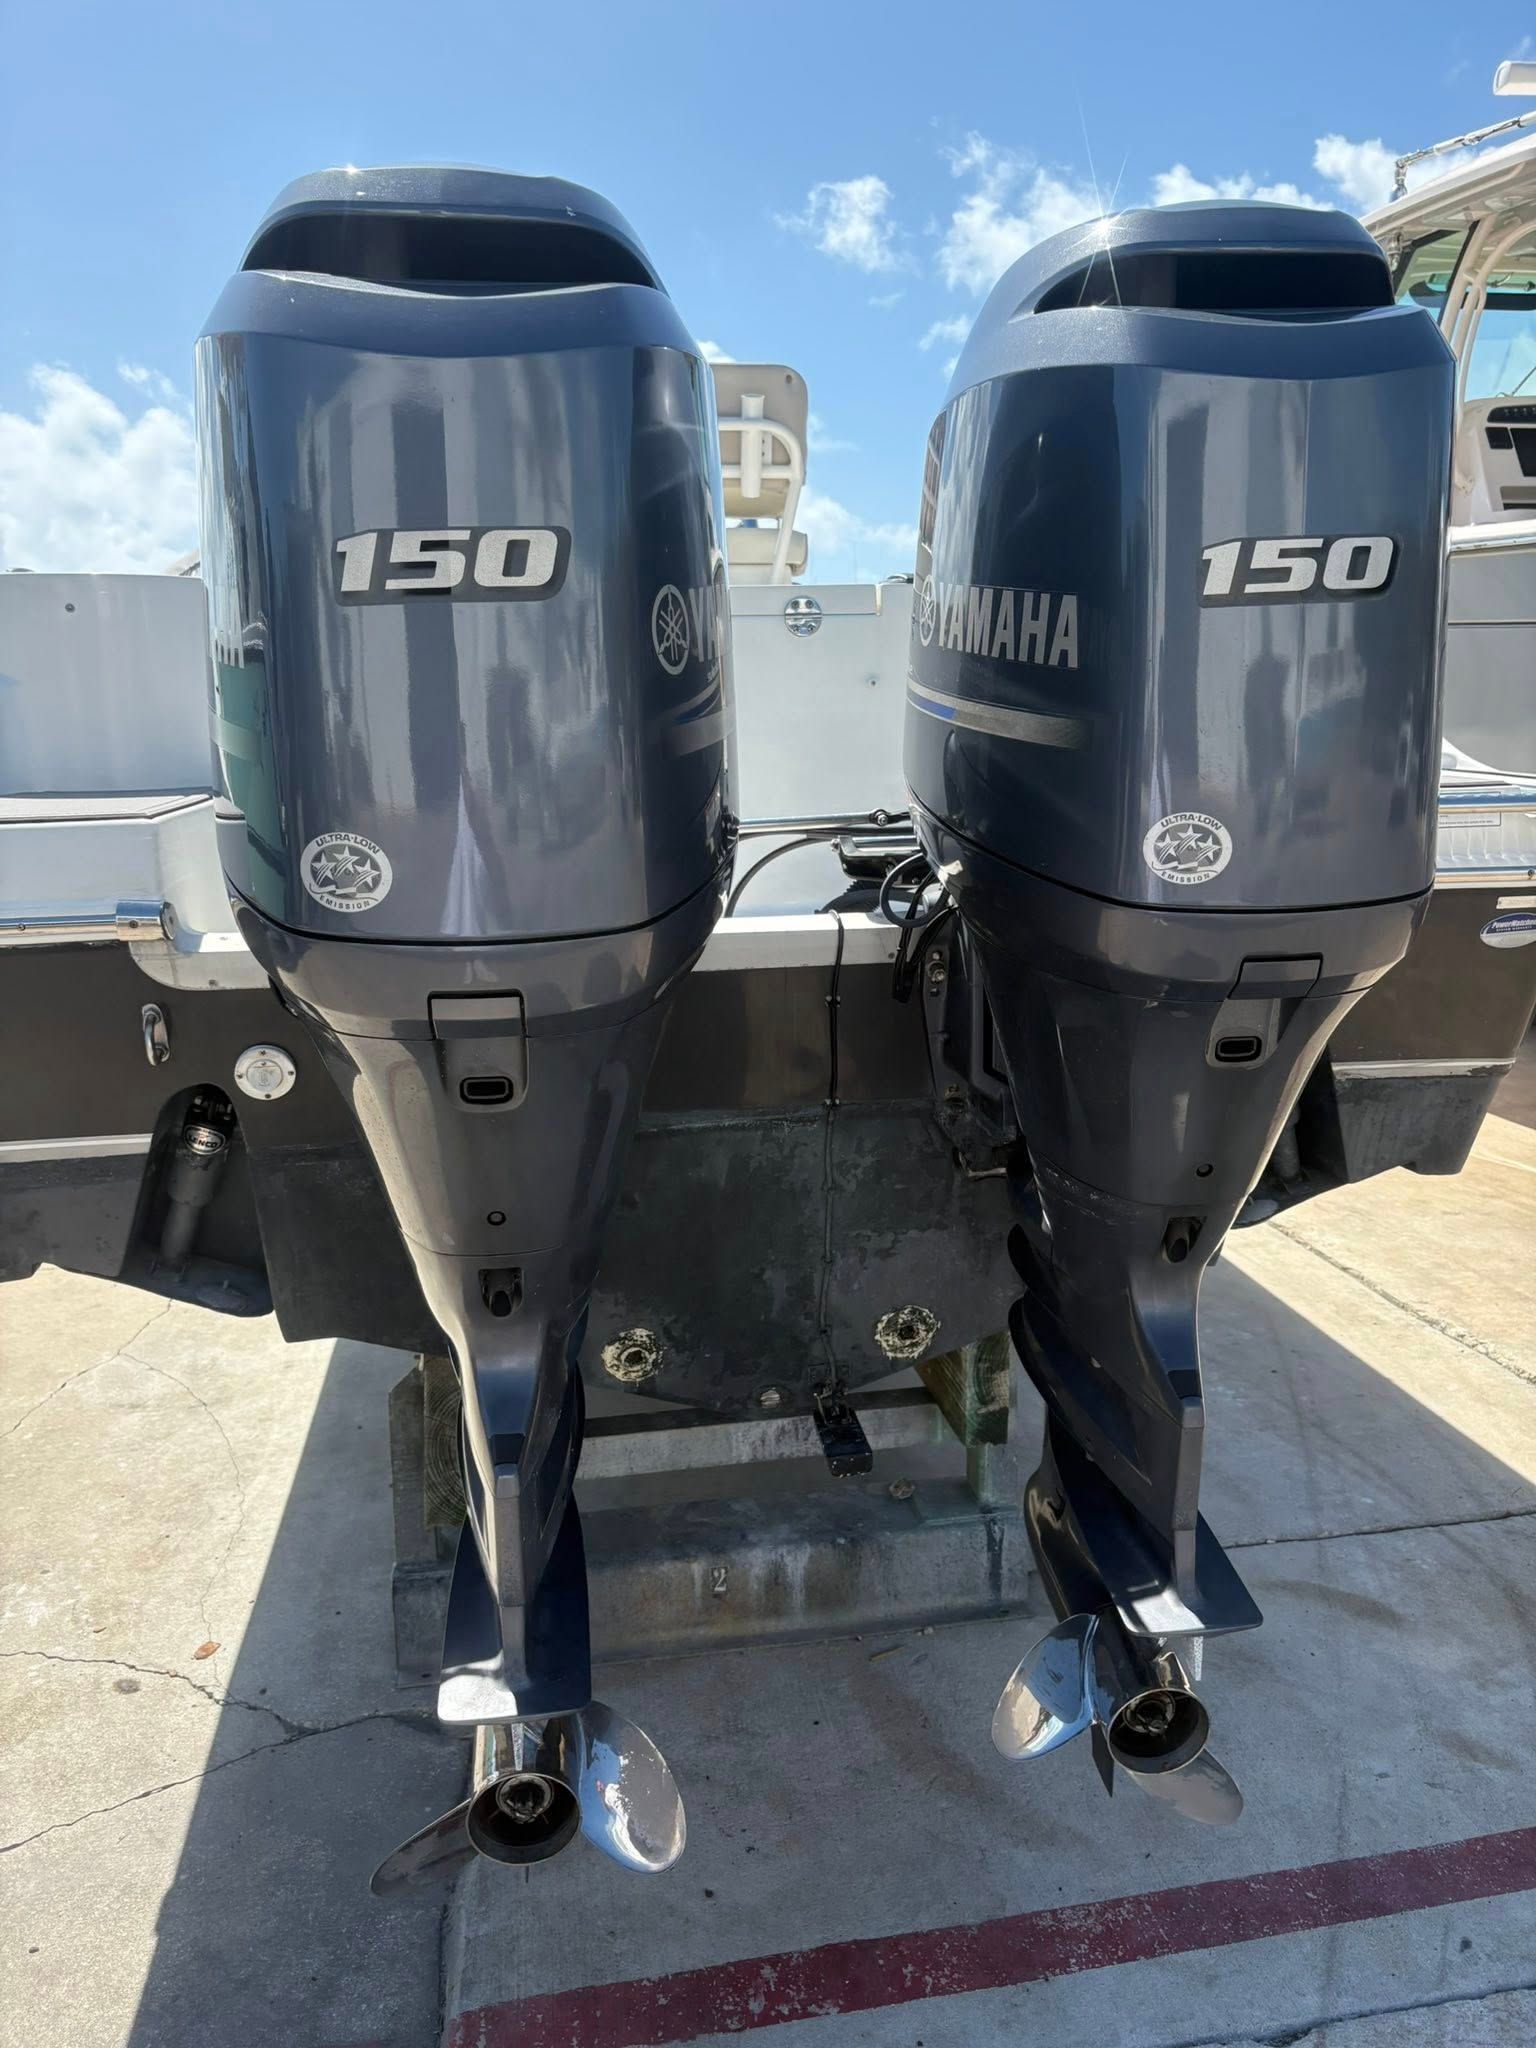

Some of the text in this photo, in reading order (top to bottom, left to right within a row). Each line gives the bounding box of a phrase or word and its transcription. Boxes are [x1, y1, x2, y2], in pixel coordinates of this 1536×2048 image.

[336, 529, 558, 592] 150
[1202, 536, 1394, 596] 150
[938, 582, 1078, 668] YAMAHA
[1161, 870, 1211, 883] EMISSION
[319, 895, 371, 910] EMISSION
[713, 1567, 727, 1592] 2
